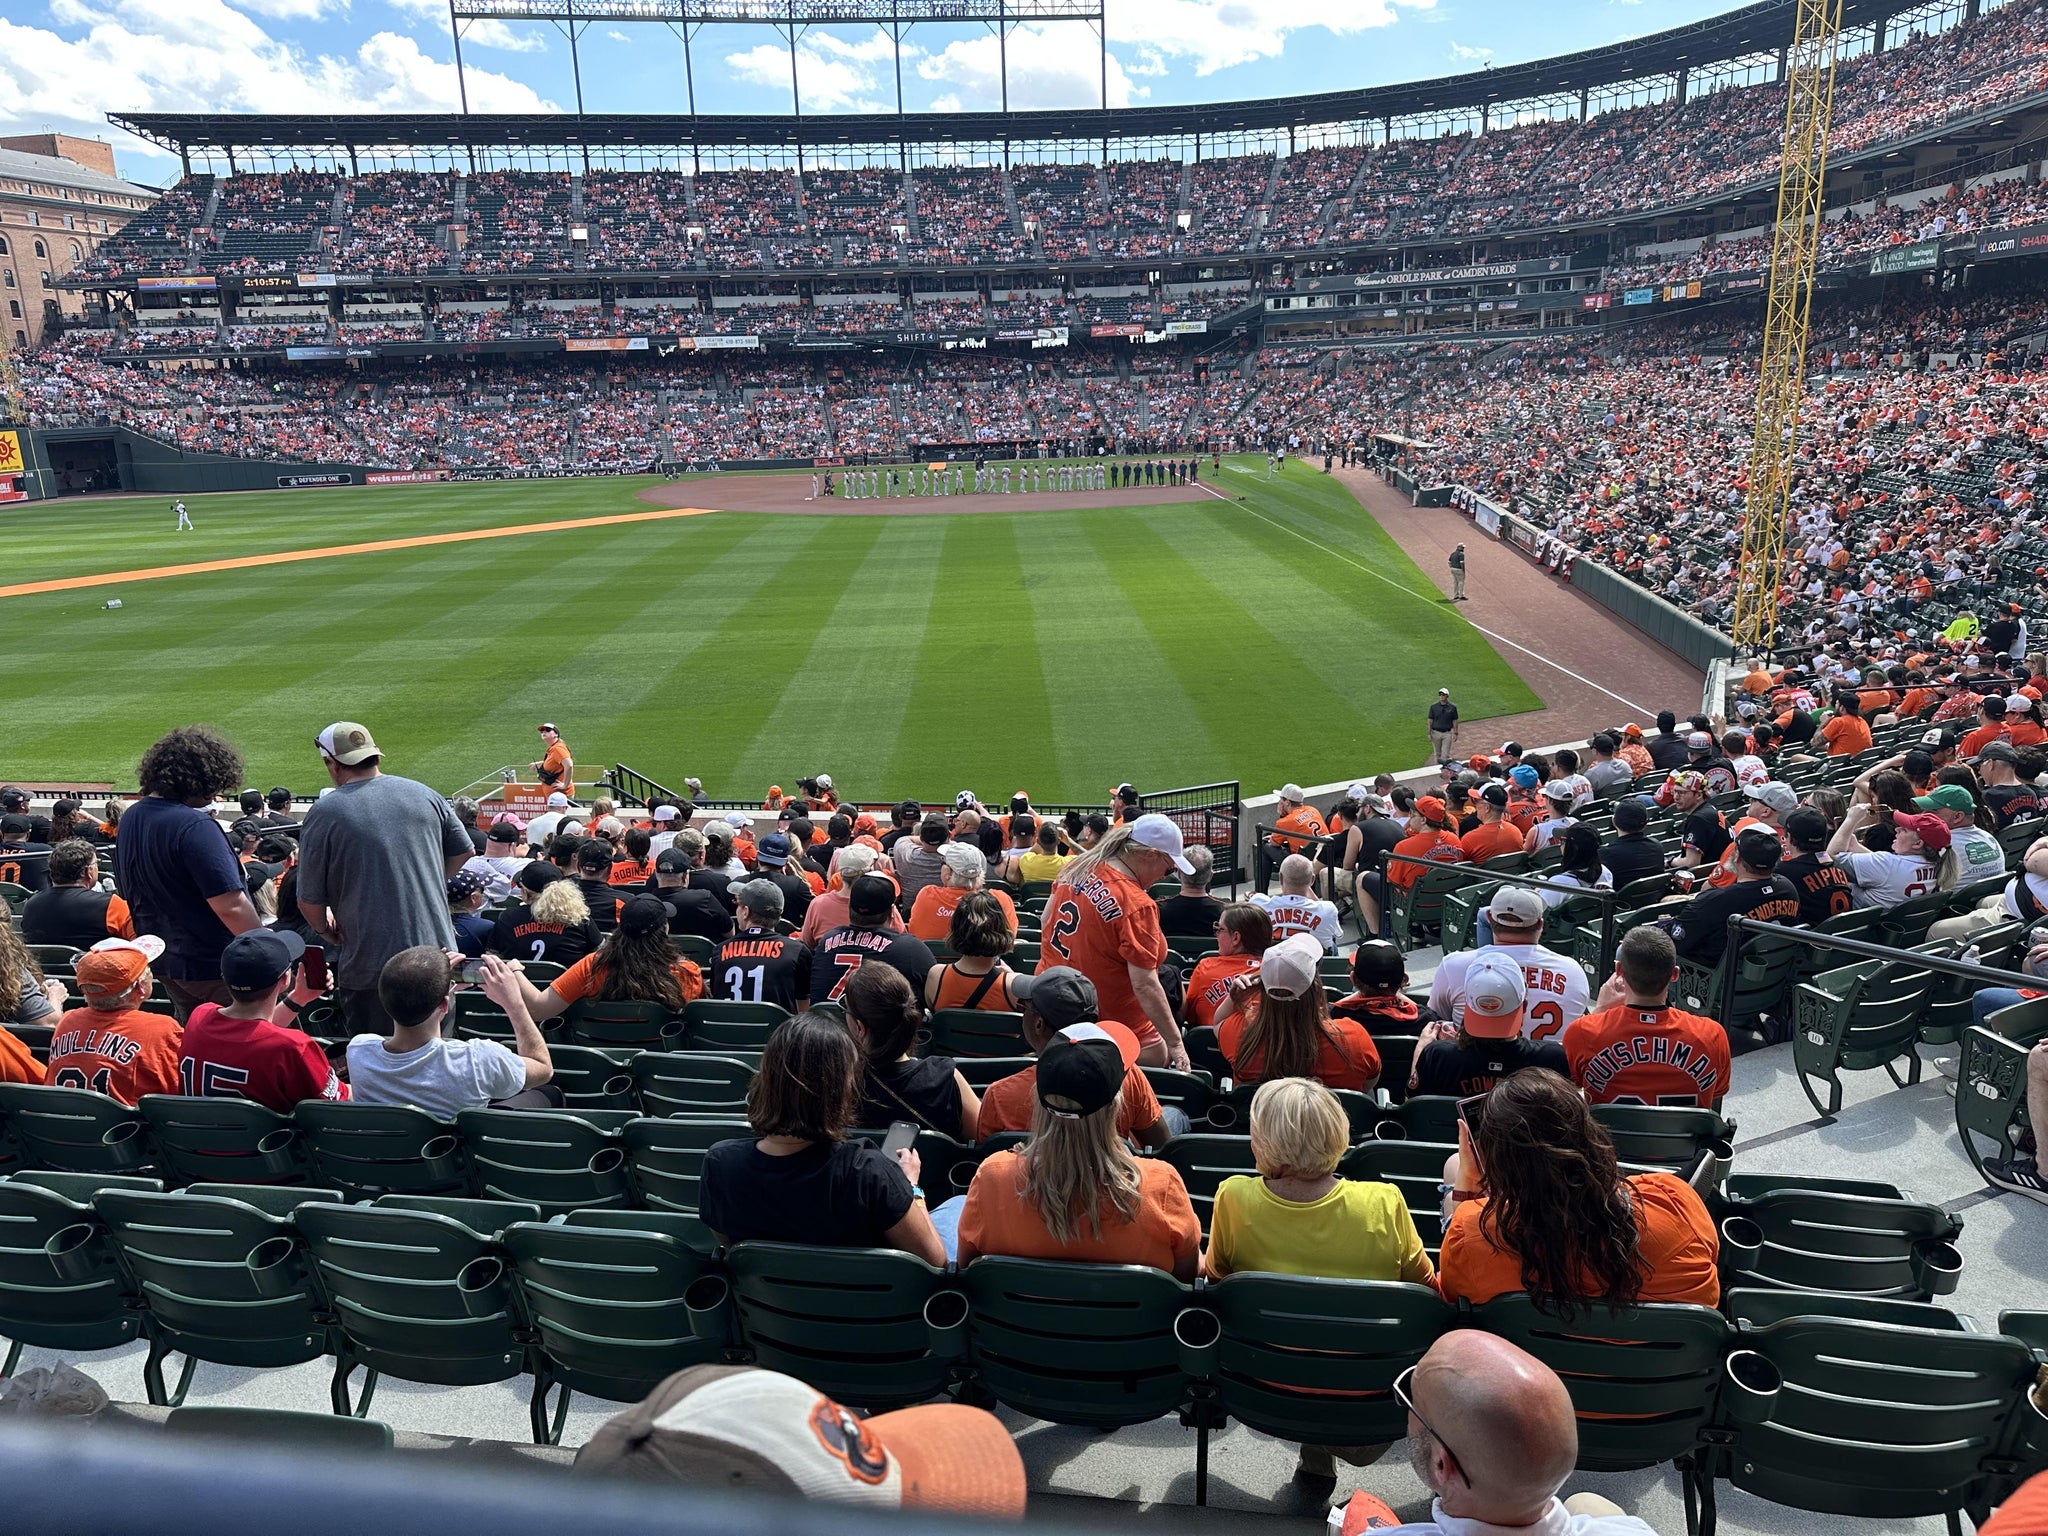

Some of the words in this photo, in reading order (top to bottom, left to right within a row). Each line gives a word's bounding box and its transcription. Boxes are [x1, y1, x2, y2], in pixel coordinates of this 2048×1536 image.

[1980, 239, 2014, 254] ubeo.com
[2021, 235, 2048, 248] SHAR
[244, 278, 280, 286] 2:10:57
[1386, 272, 1419, 284] ORIOLE
[1420, 271, 1442, 281] PARK
[1452, 267, 1488, 279] CAMDEN
[1488, 264, 1516, 275] YARDS
[897, 333, 925, 342] SHIFT
[1969, 624, 1976, 635] 2
[614, 866, 655, 881] ROBINSO
[514, 922, 565, 938] HENDERSON
[1050, 900, 1081, 960] 2
[531, 939, 545, 962] 2
[824, 930, 892, 952] HOLLIDAY
[721, 942, 784, 962] MULLINS
[724, 966, 764, 1004] 31
[827, 954, 863, 1001] 7
[1204, 974, 1241, 1005] HEN
[50, 1030, 141, 1065] MULLINS
[1811, 1034, 1820, 1043] 10
[1584, 1036, 1717, 1093] RUTSCHMAN
[180, 1056, 249, 1098] 15
[1982, 1086, 1992, 1096] 11
